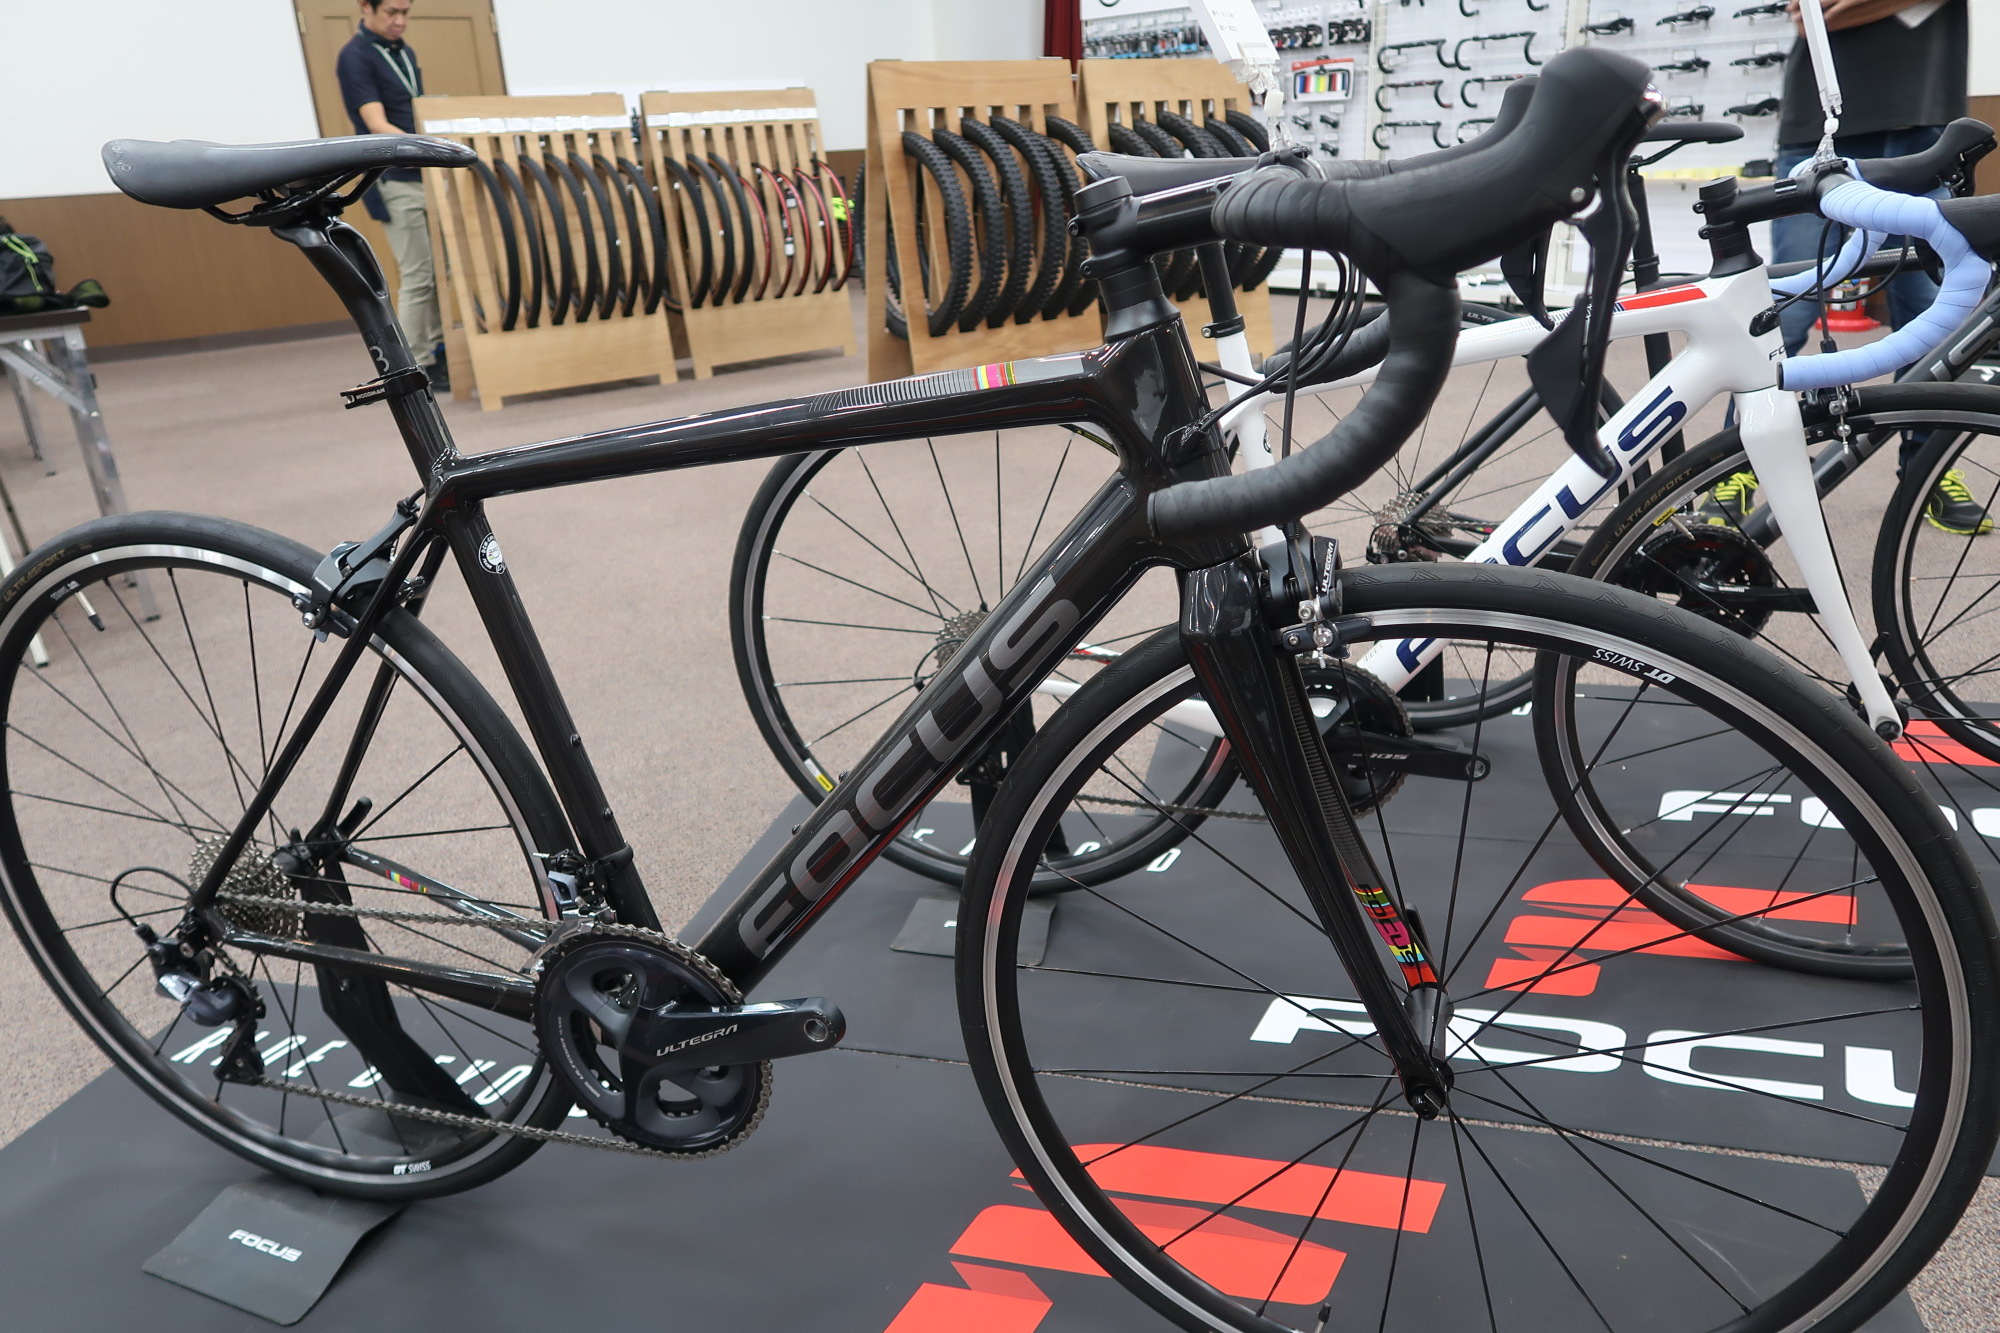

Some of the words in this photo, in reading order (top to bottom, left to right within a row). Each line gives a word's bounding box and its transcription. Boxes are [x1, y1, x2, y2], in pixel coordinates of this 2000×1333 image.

[1321, 541, 1334, 593] ULTEGRA
[1592, 648, 1645, 672] SWISS
[1643, 668, 1677, 685] DT
[739, 573, 1081, 959] FOCUS
[656, 1024, 739, 1057] ULTEGRA
[408, 1160, 431, 1174] SWISS
[228, 1228, 304, 1263] FOCUS
